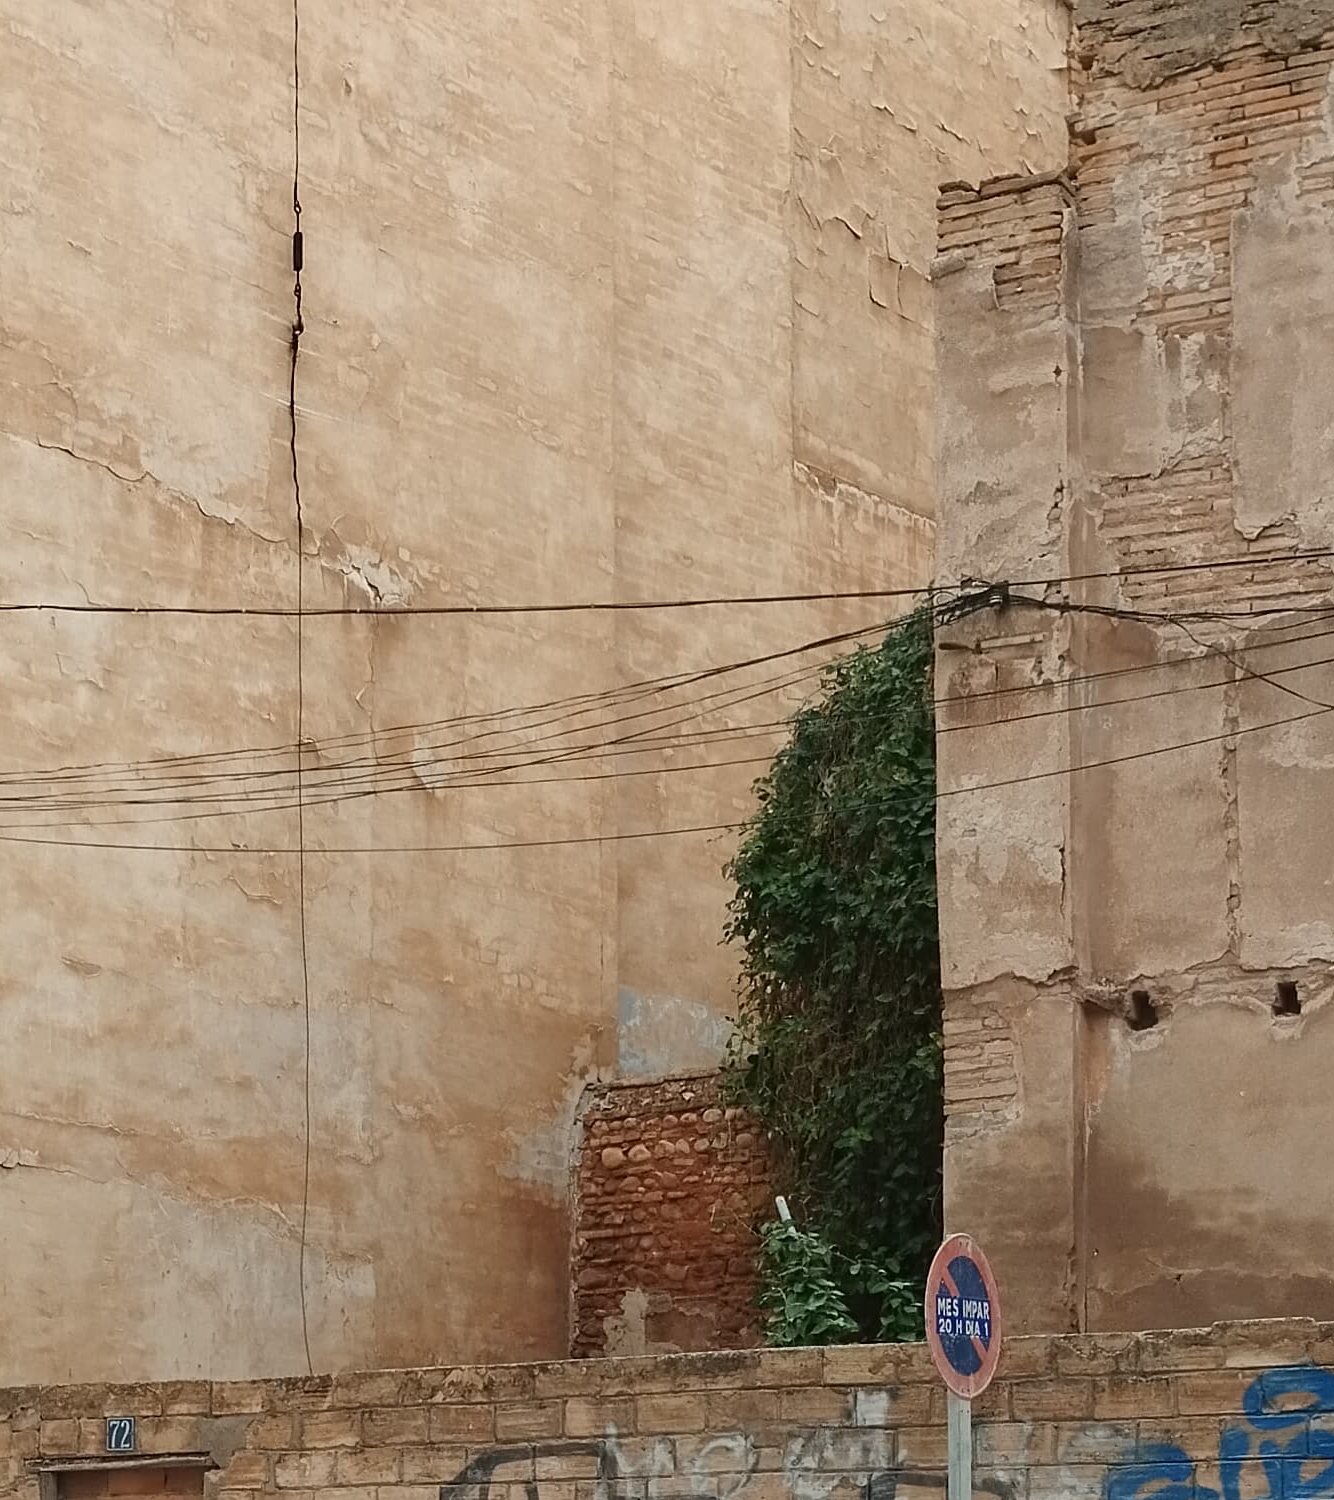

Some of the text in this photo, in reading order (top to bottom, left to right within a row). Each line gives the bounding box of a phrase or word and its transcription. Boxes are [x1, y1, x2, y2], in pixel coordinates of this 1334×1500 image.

[937, 1296, 989, 1320] MES IMPAR
[938, 1318, 989, 1337] 20 H DIA 1
[109, 1420, 130, 1448] 72
